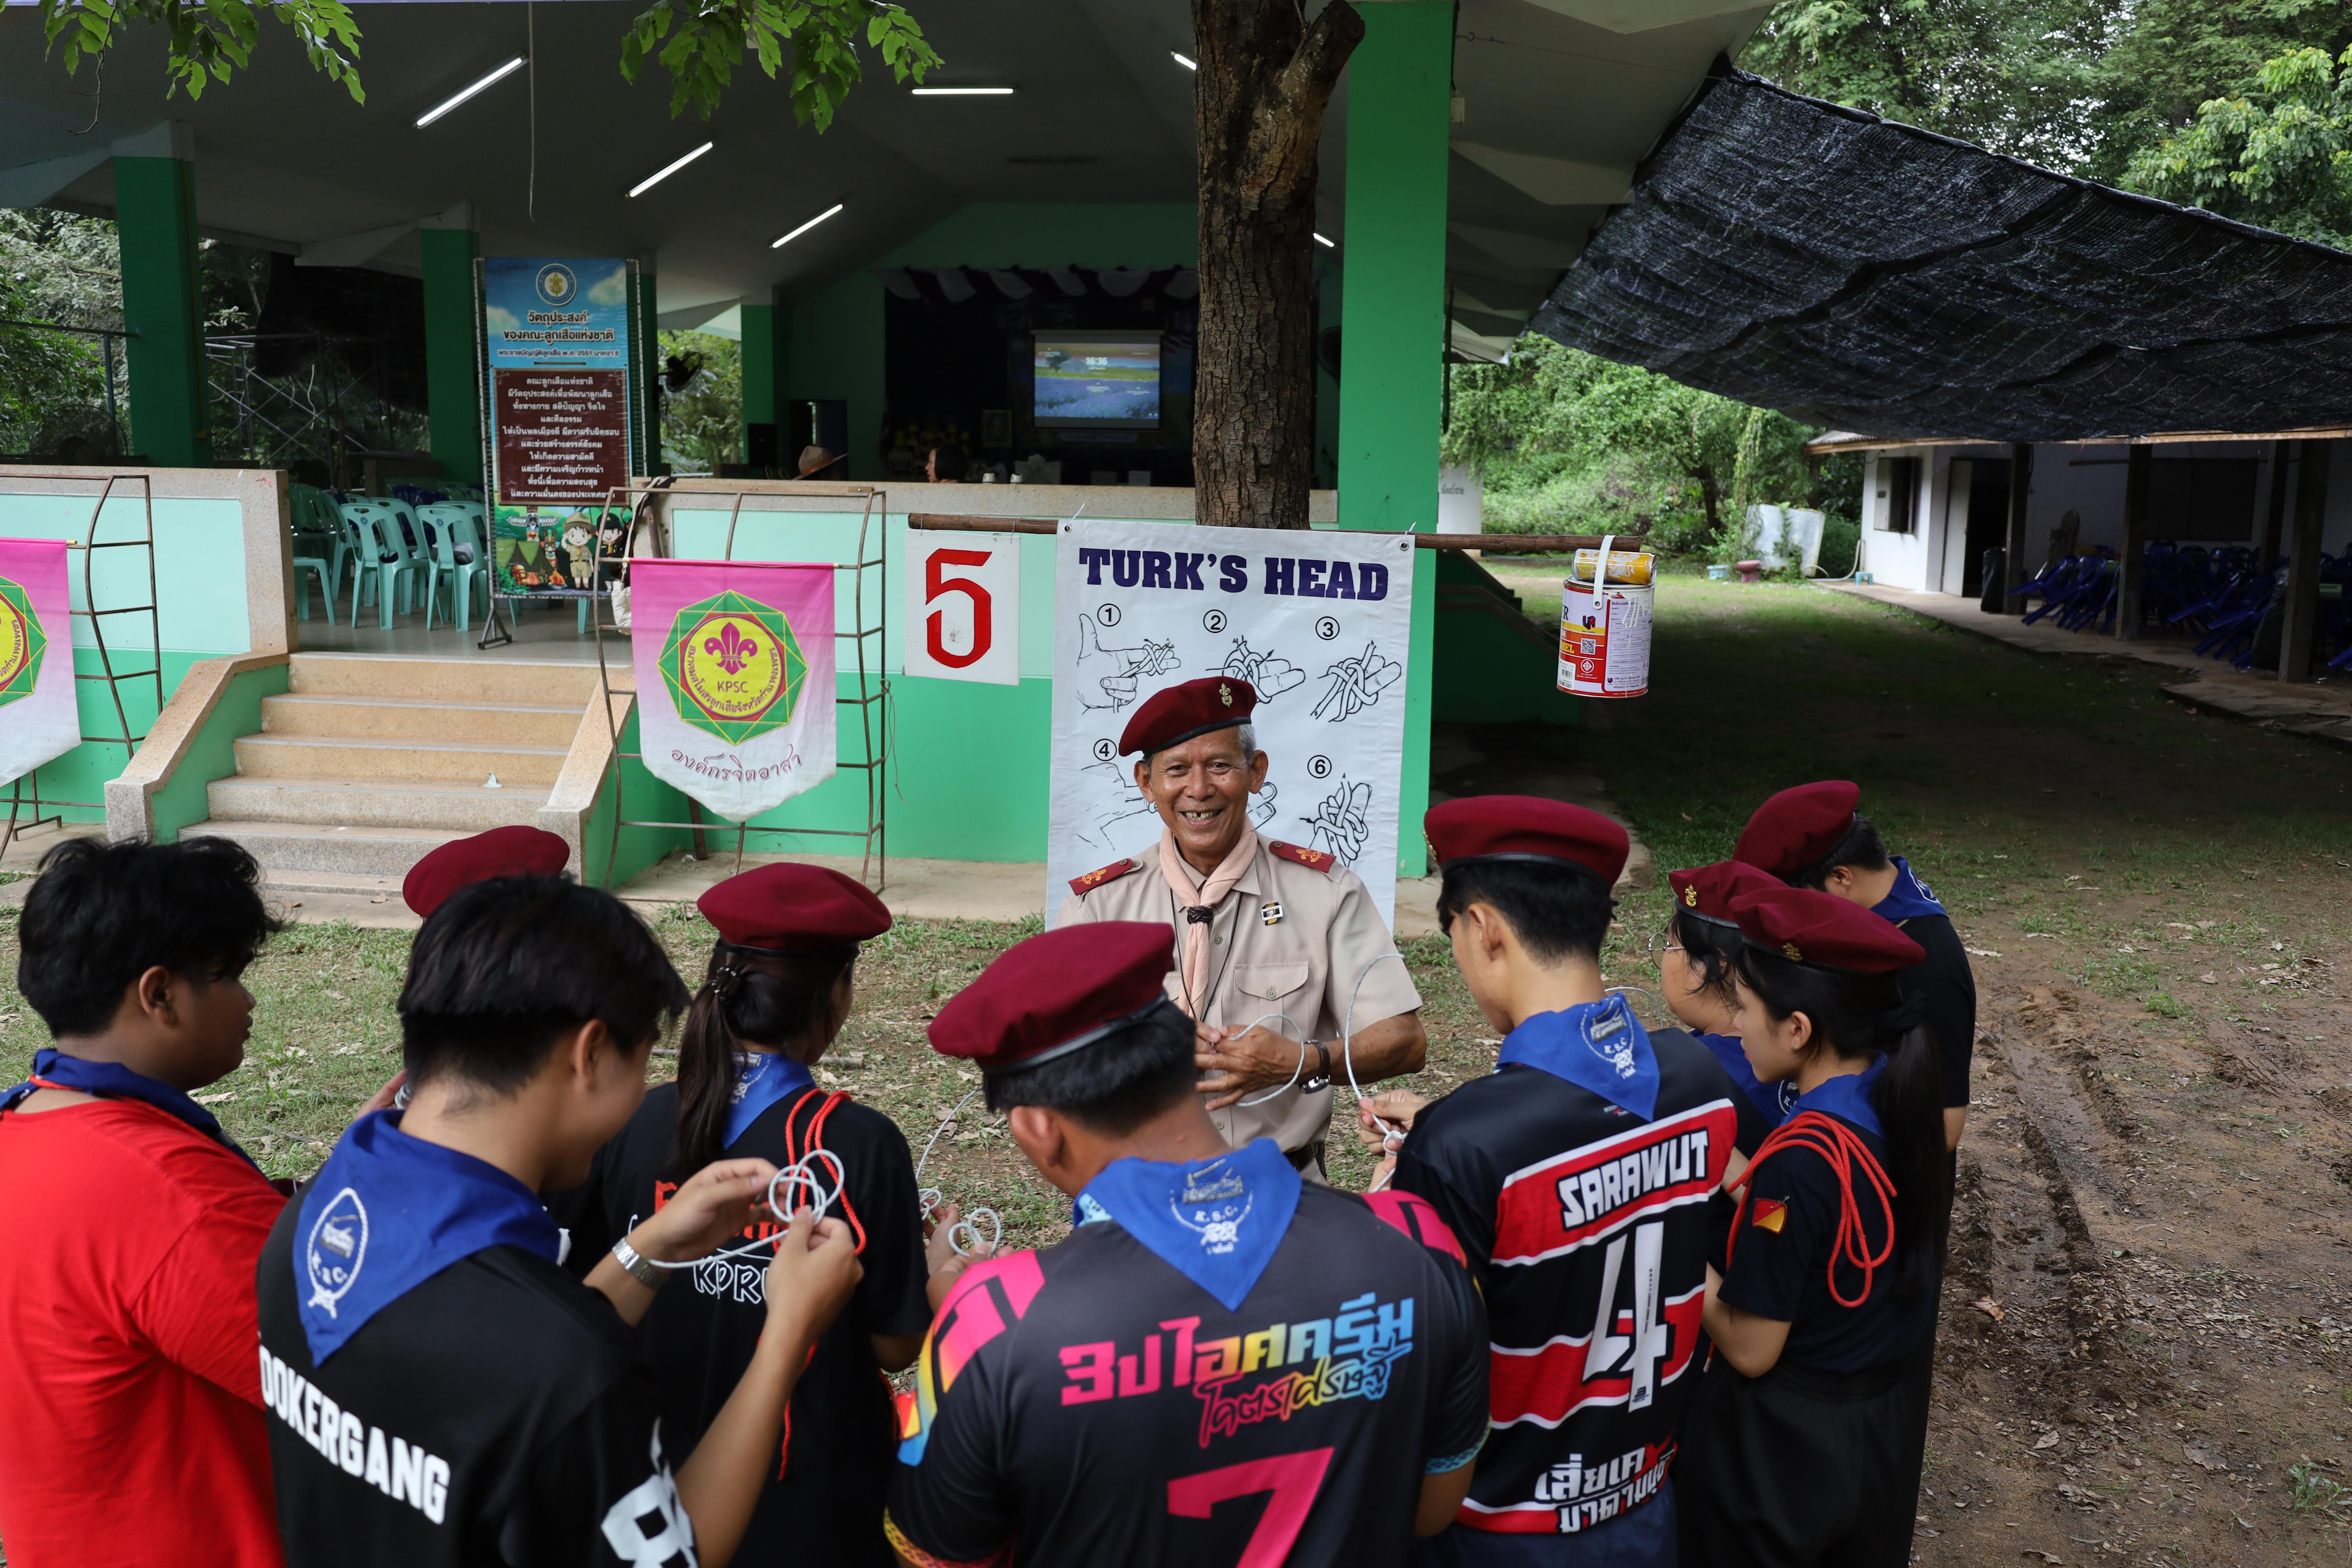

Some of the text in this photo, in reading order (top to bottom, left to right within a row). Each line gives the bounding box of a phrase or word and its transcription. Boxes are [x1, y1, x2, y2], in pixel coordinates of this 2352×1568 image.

[504, 328, 614, 345] ของคณะลูกเสือแห่งชาติ
[528, 310, 588, 328] วัตถุประสงค์
[925, 548, 992, 668] 5
[1079, 548, 1389, 601] TURK'S HEAD
[717, 681, 748, 693] KPSC
[671, 743, 802, 782] องค์กรจิตอาสา
[1559, 1132, 1708, 1227] SARAWUT
[1583, 1221, 1664, 1413] 4
[259, 1332, 450, 1525] OOKERGANG
[1167, 1446, 1334, 1568] 7
